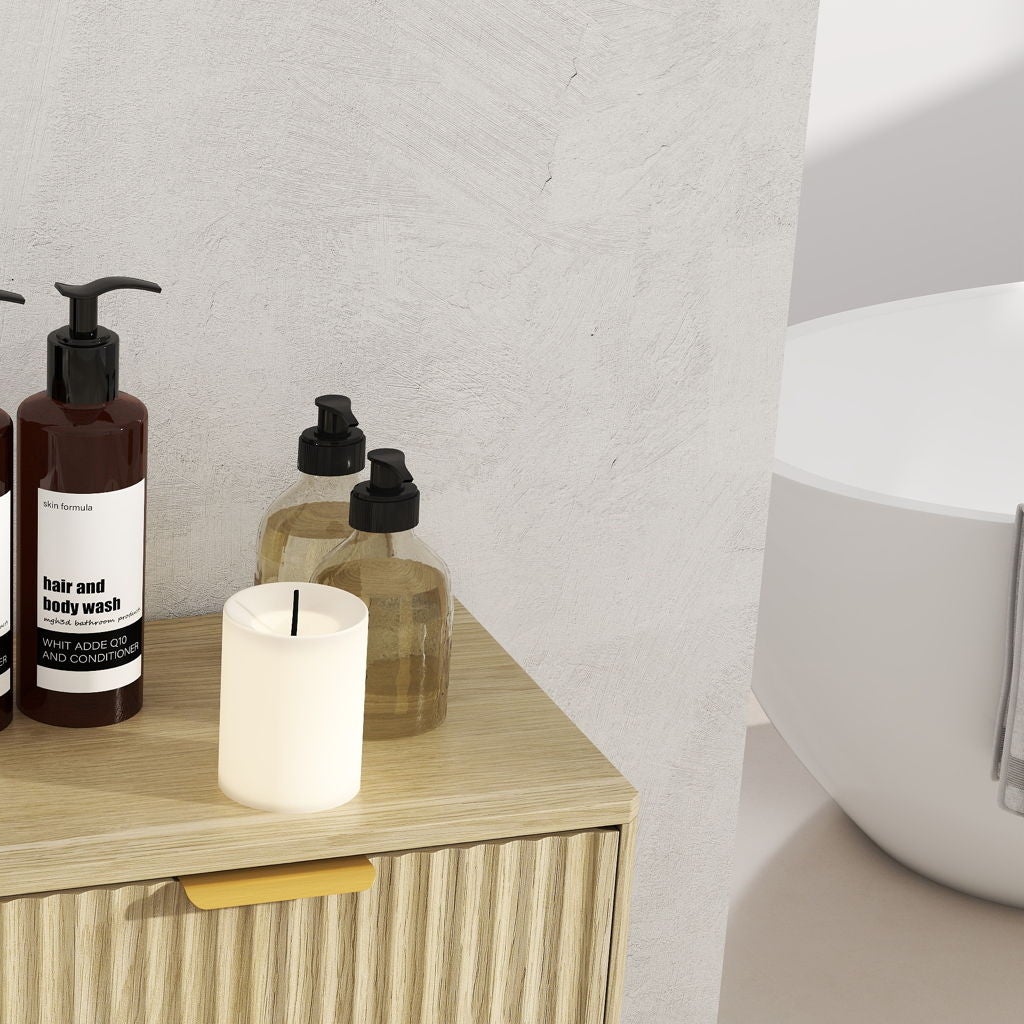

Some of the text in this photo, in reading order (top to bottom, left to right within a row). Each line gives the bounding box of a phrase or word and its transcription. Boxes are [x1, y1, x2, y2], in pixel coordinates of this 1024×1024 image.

[43, 501, 93, 512] skin formula
[43, 576, 105, 594] hair and
[43, 596, 121, 616] body wash
[42, 635, 128, 651] WHIT ADDE Q10
[42, 641, 139, 664] AND CONDITIONER
